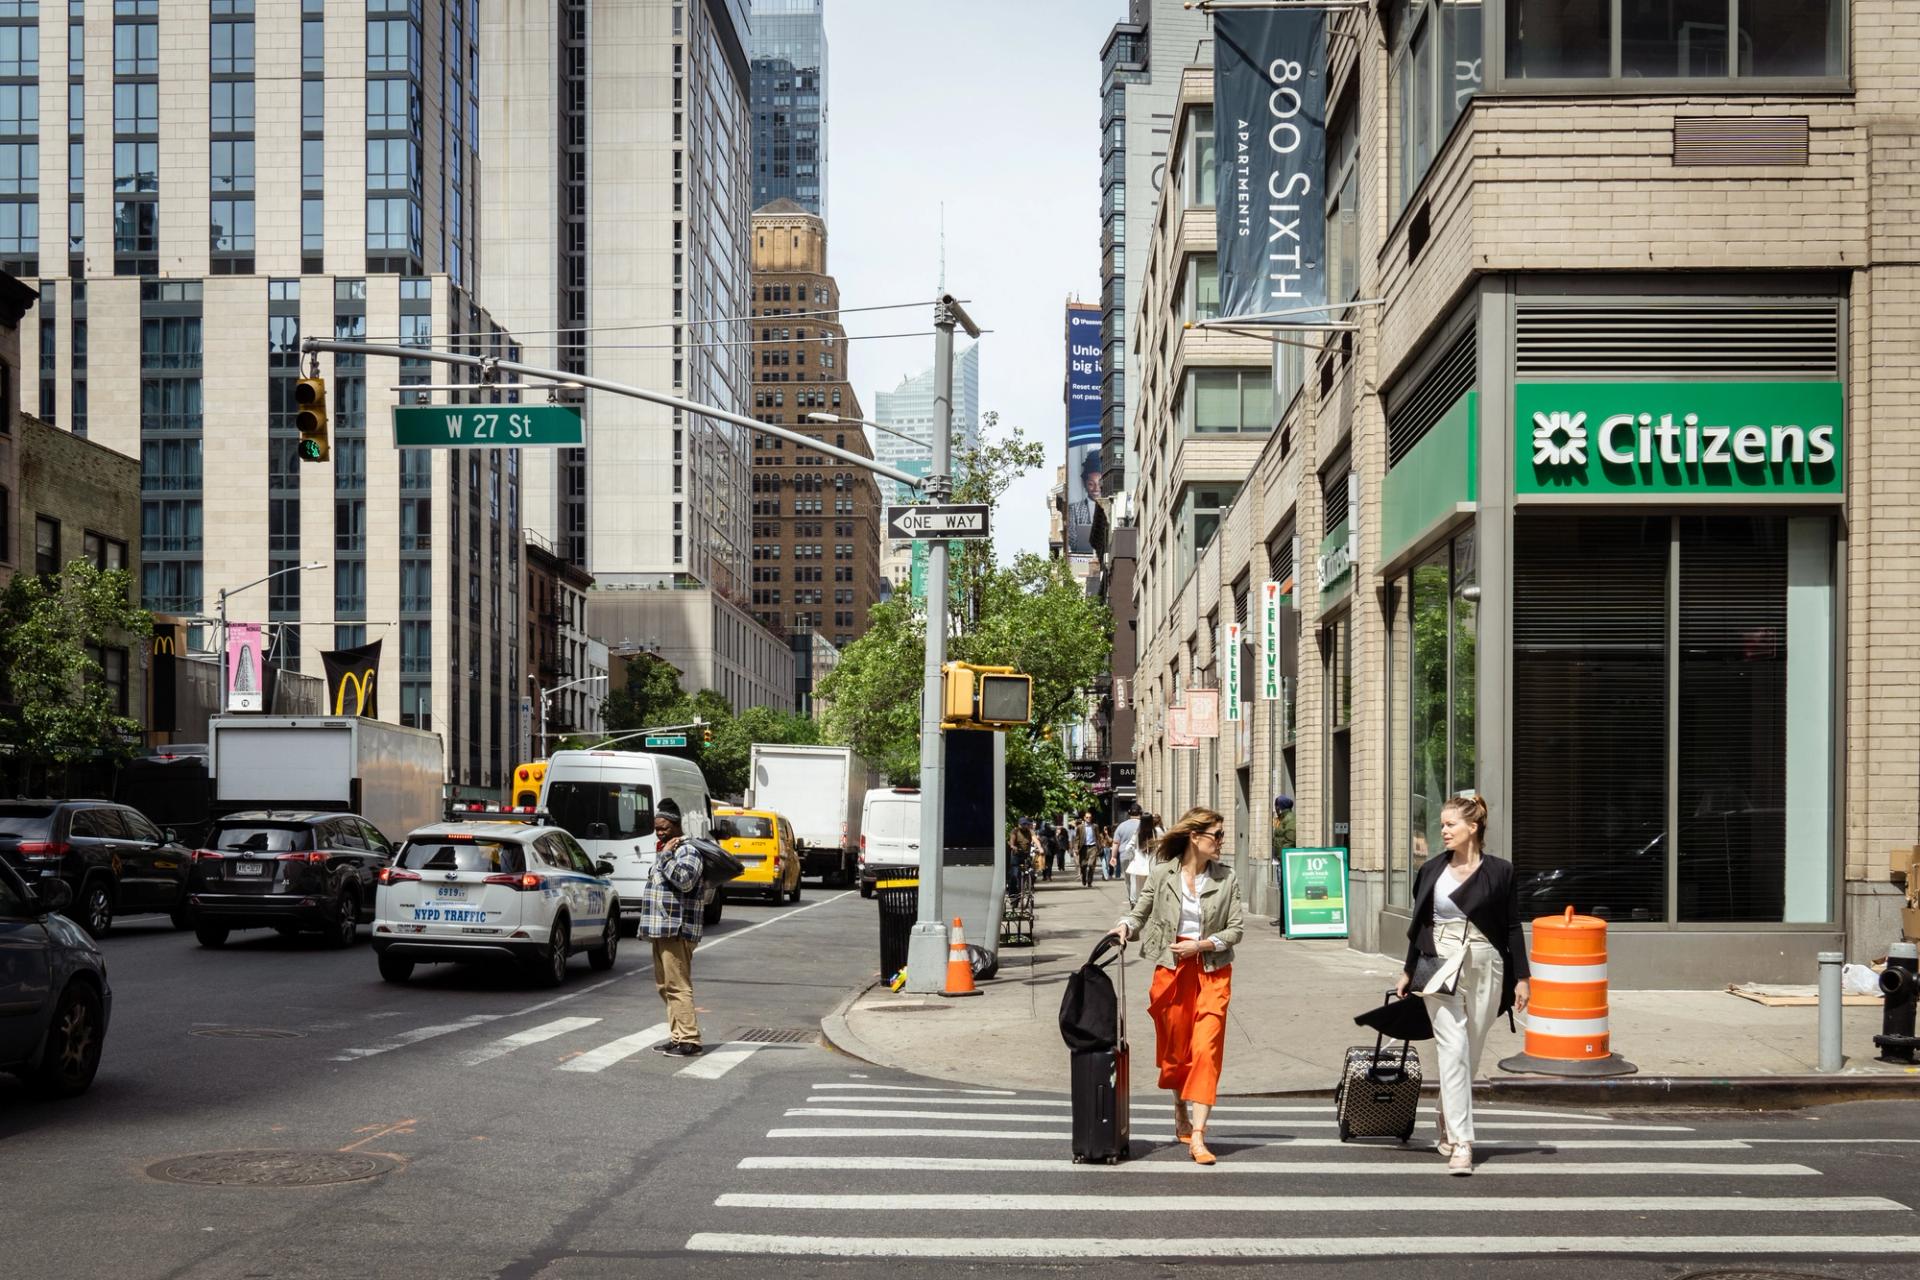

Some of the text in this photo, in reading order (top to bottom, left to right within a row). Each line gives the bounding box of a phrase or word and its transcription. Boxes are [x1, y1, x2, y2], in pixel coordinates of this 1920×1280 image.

[1237, 119, 1250, 236] APARTMENTS
[1268, 58, 1311, 299] 800 SIXTH
[1072, 344, 1102, 356] Unlo
[1072, 360, 1092, 375] big
[445, 413, 532, 438] W 27 St
[1598, 413, 1835, 464] Citizens
[903, 515, 976, 529] ONE WAY
[414, 908, 487, 923] NYPD TRAFFIC
